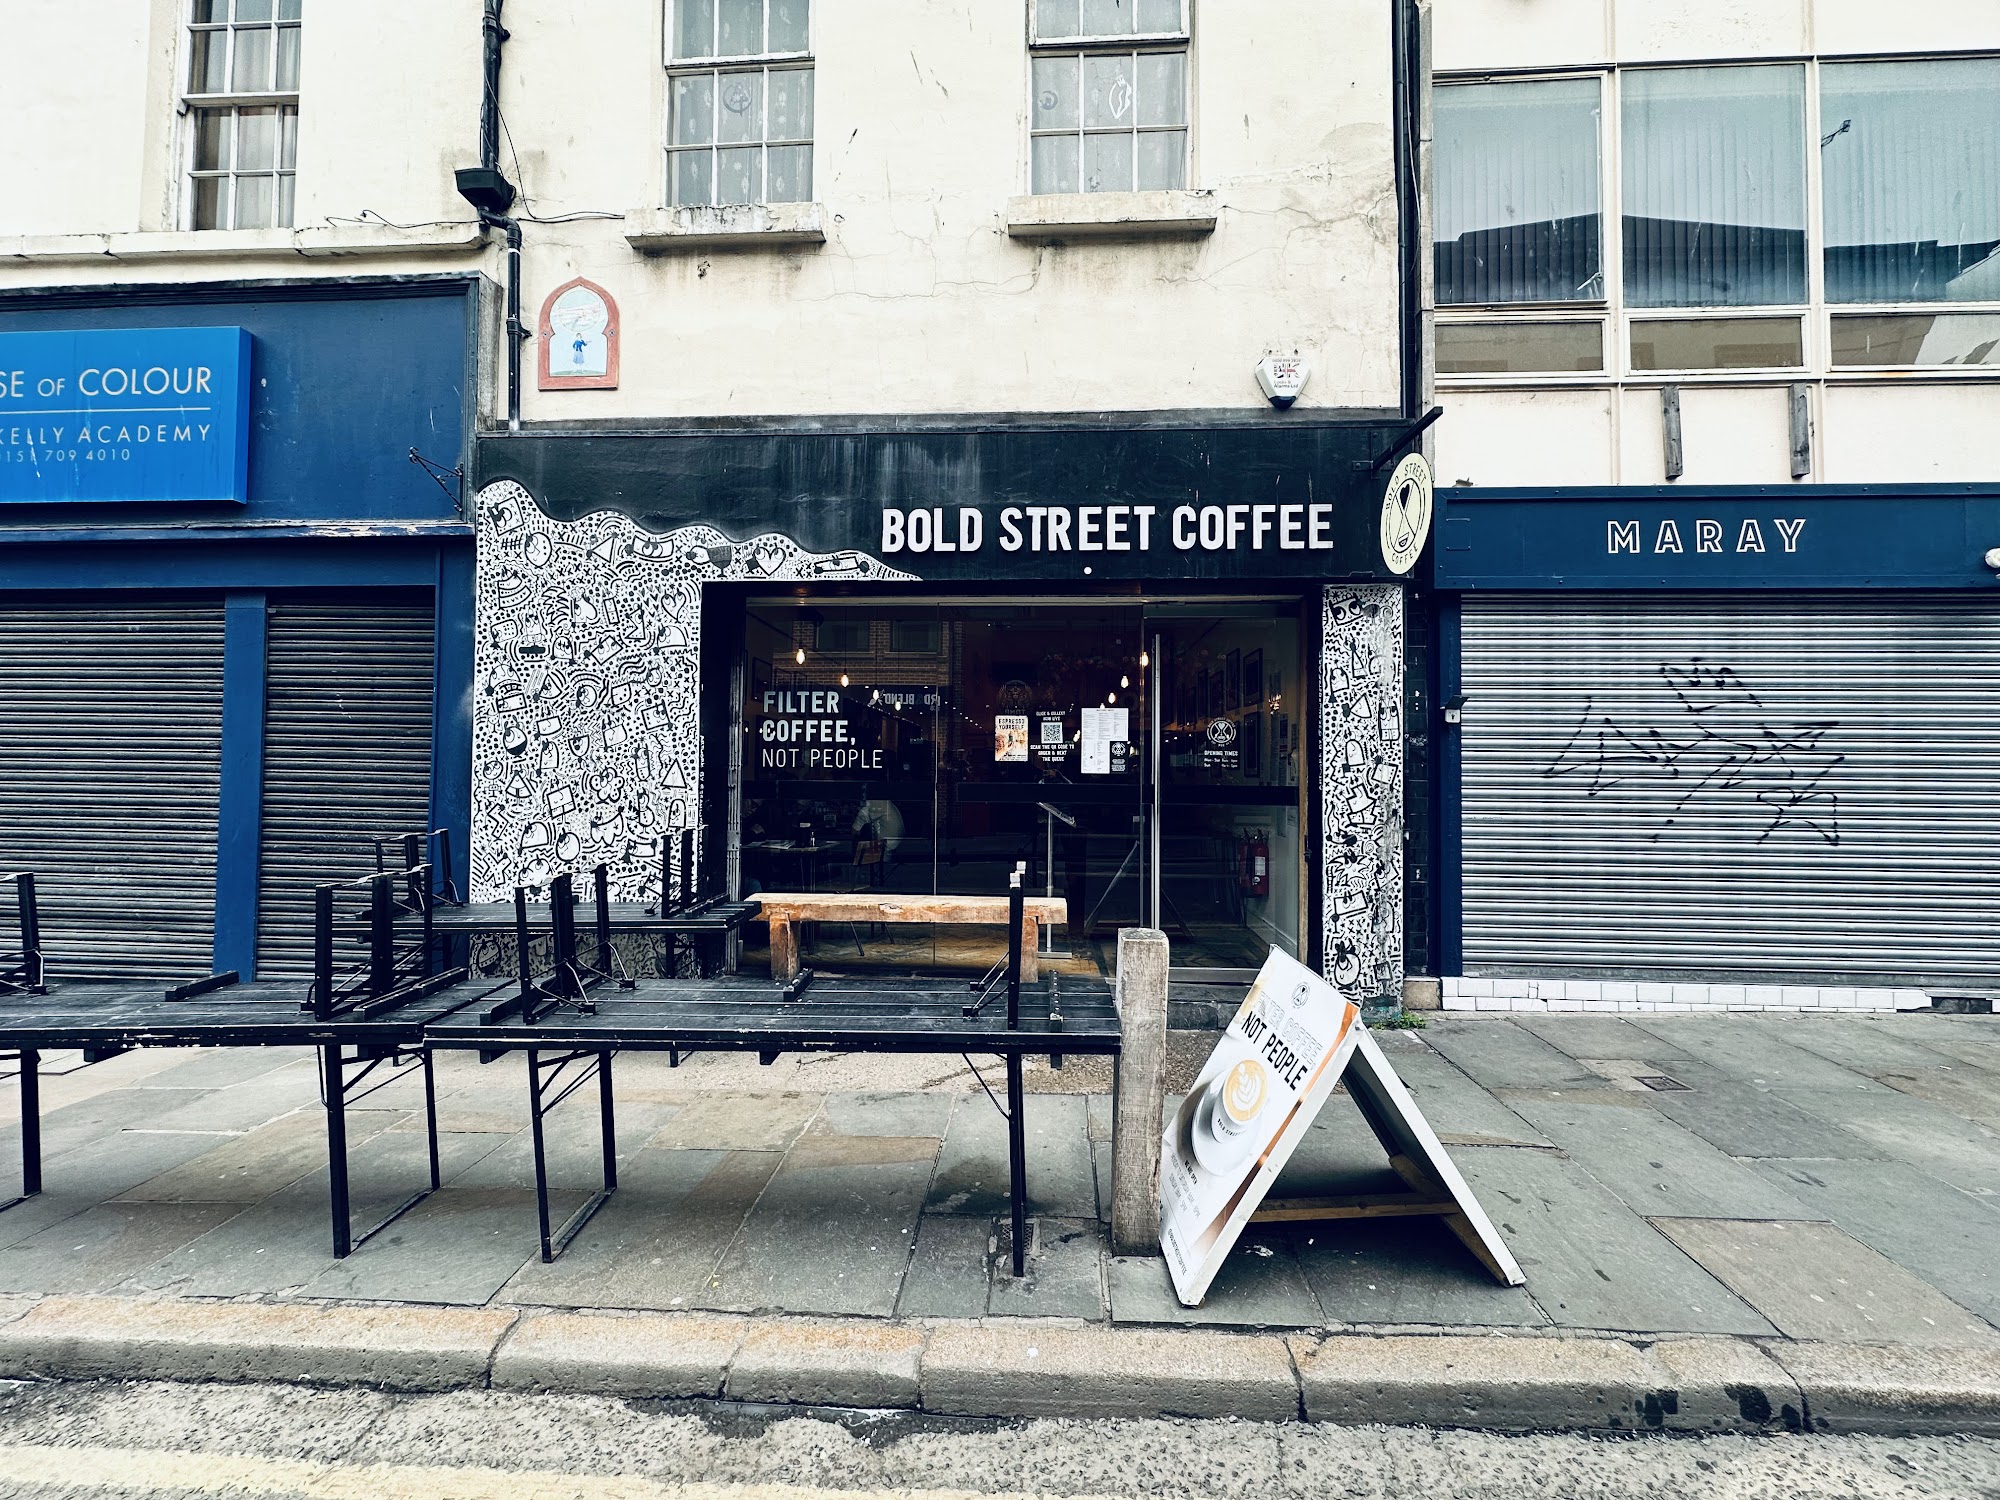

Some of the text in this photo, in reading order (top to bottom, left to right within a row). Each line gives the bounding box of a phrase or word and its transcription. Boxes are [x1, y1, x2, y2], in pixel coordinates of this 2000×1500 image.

[37, 378, 65, 397] OF
[79, 367, 211, 396] COLOUR
[78, 424, 211, 443] ACADEMY
[45, 449, 77, 462] 709
[86, 449, 130, 461] 4010
[1385, 462, 1427, 510] BOLD STREET
[882, 503, 1334, 552] BOLD STREET COFFEE
[1607, 518, 1807, 554] MARAY
[1391, 543, 1419, 566] COFFEE
[763, 690, 840, 713] FILTER
[762, 719, 856, 746] COFFEE,
[762, 748, 883, 769] NOT PEOPLE
[699, 771, 705, 781] BY
[1241, 1010, 1267, 1044] NOT
[1261, 1032, 1308, 1091] PEOPLE
